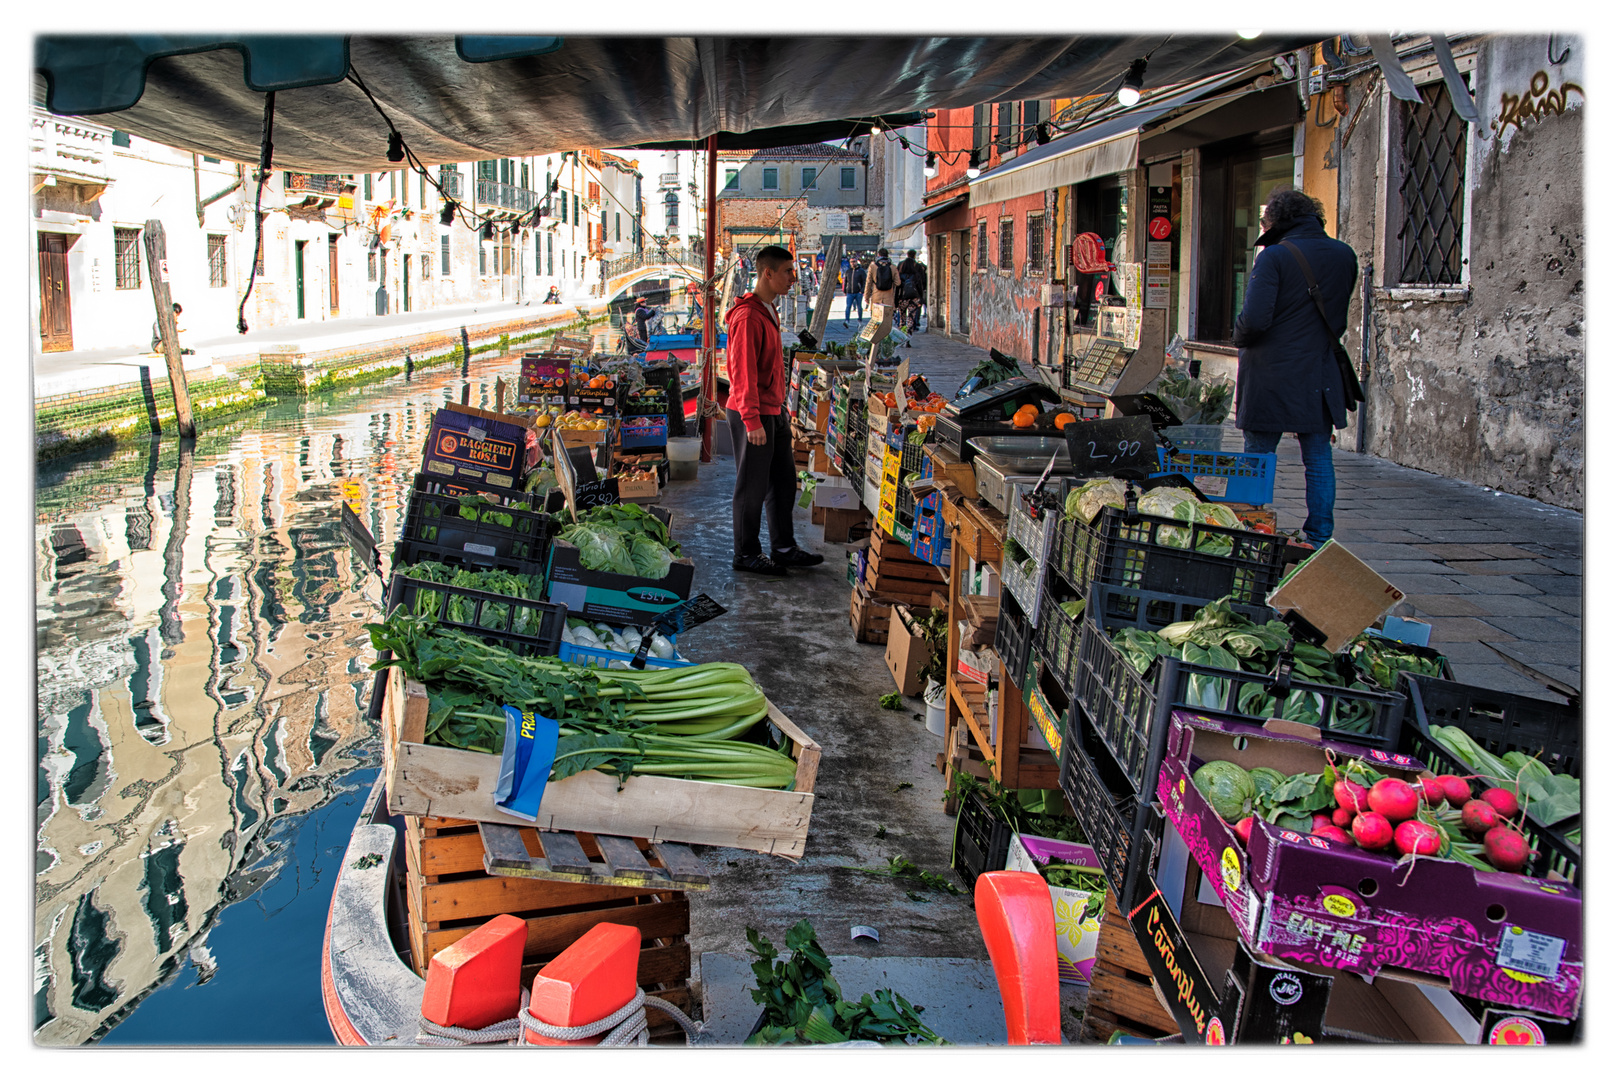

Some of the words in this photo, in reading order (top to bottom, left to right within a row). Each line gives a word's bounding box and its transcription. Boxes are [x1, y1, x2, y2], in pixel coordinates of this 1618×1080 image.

[459, 436, 513, 457] BAGGIERI
[469, 449, 498, 464] ROSA
[1088, 440, 1141, 464] 2,90
[640, 590, 667, 602] ESLY
[1028, 688, 1063, 761] FONTEVERDE
[1328, 896, 1354, 910] Nature's
[1331, 904, 1347, 914] Pride
[1286, 912, 1332, 942] EAT
[1330, 930, 1367, 956] ME
[1314, 942, 1333, 954] I'M
[1335, 949, 1360, 965] RIPE
